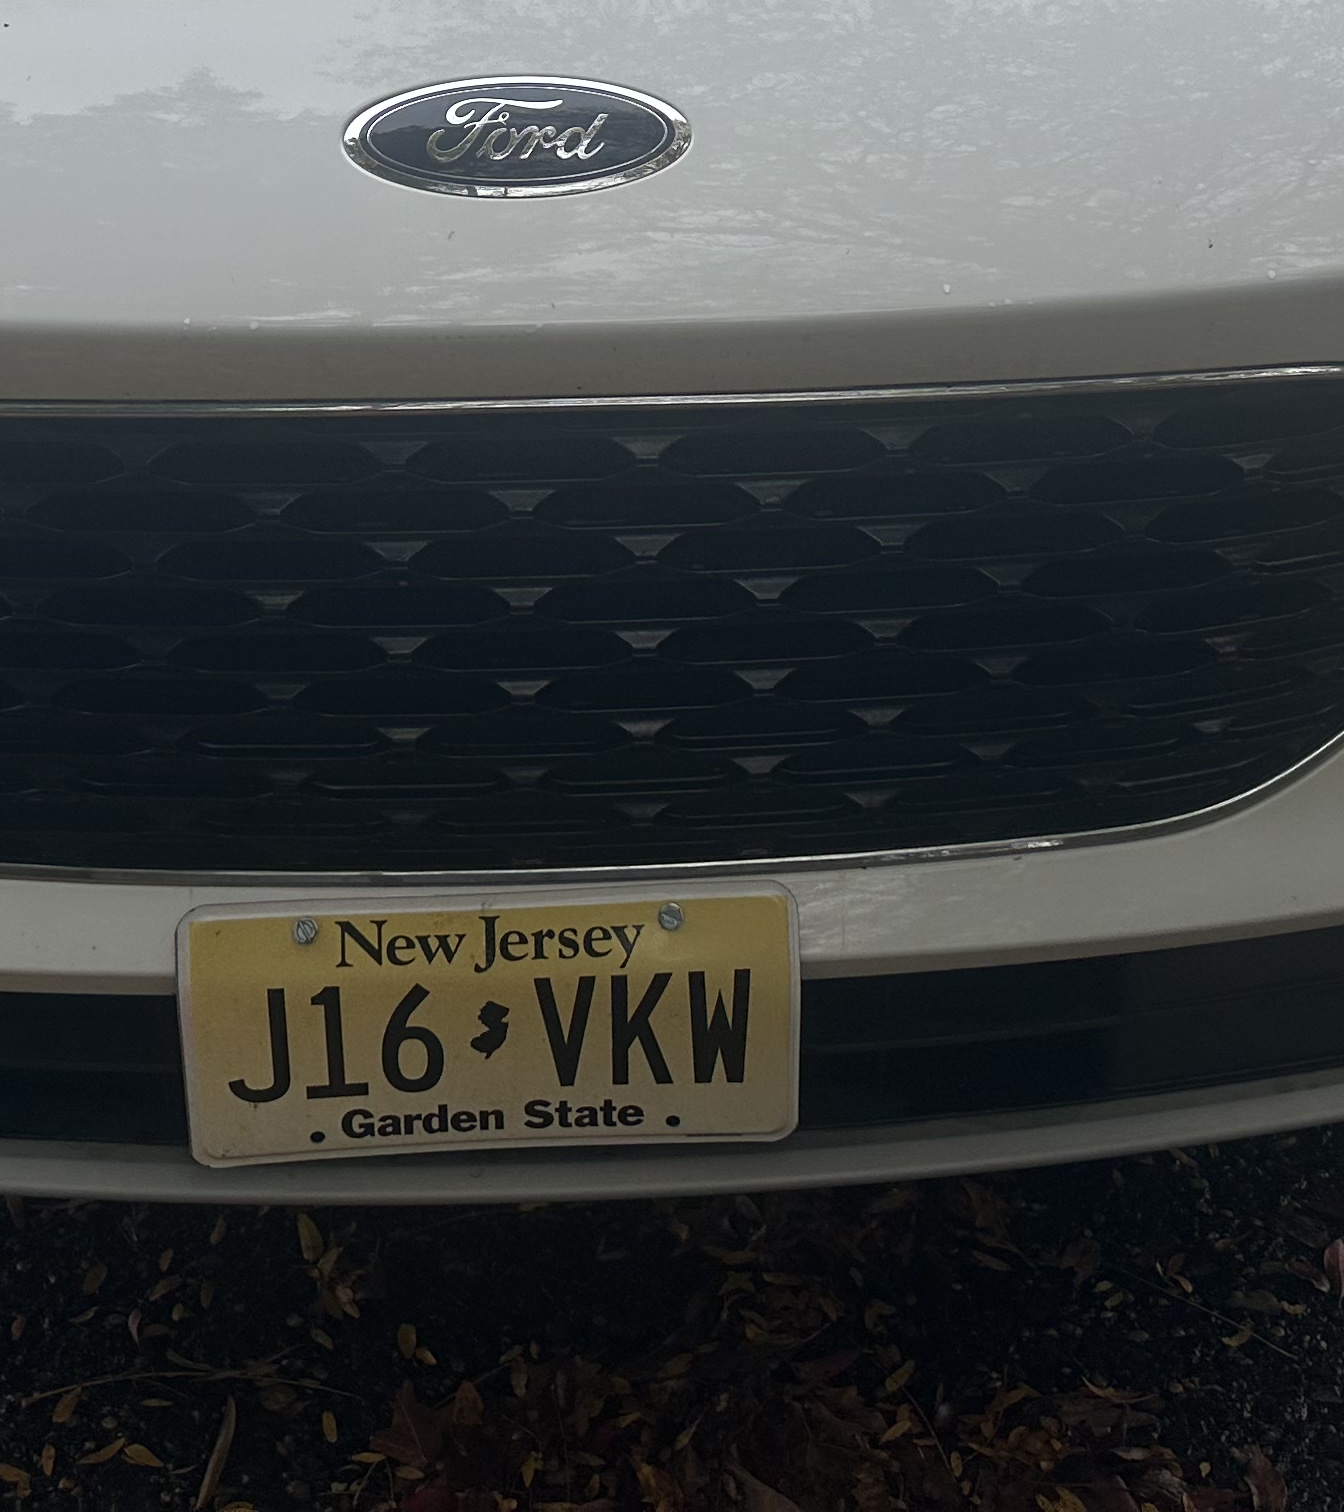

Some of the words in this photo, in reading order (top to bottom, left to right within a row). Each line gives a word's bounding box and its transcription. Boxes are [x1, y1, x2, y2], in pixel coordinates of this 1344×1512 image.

[426, 97, 609, 163] Ford
[335, 919, 466, 968] New
[473, 915, 645, 974] Jersey
[228, 982, 445, 1104] J16
[533, 968, 751, 1087] VKW
[340, 1103, 505, 1139] Garden
[523, 1098, 645, 1130] State
